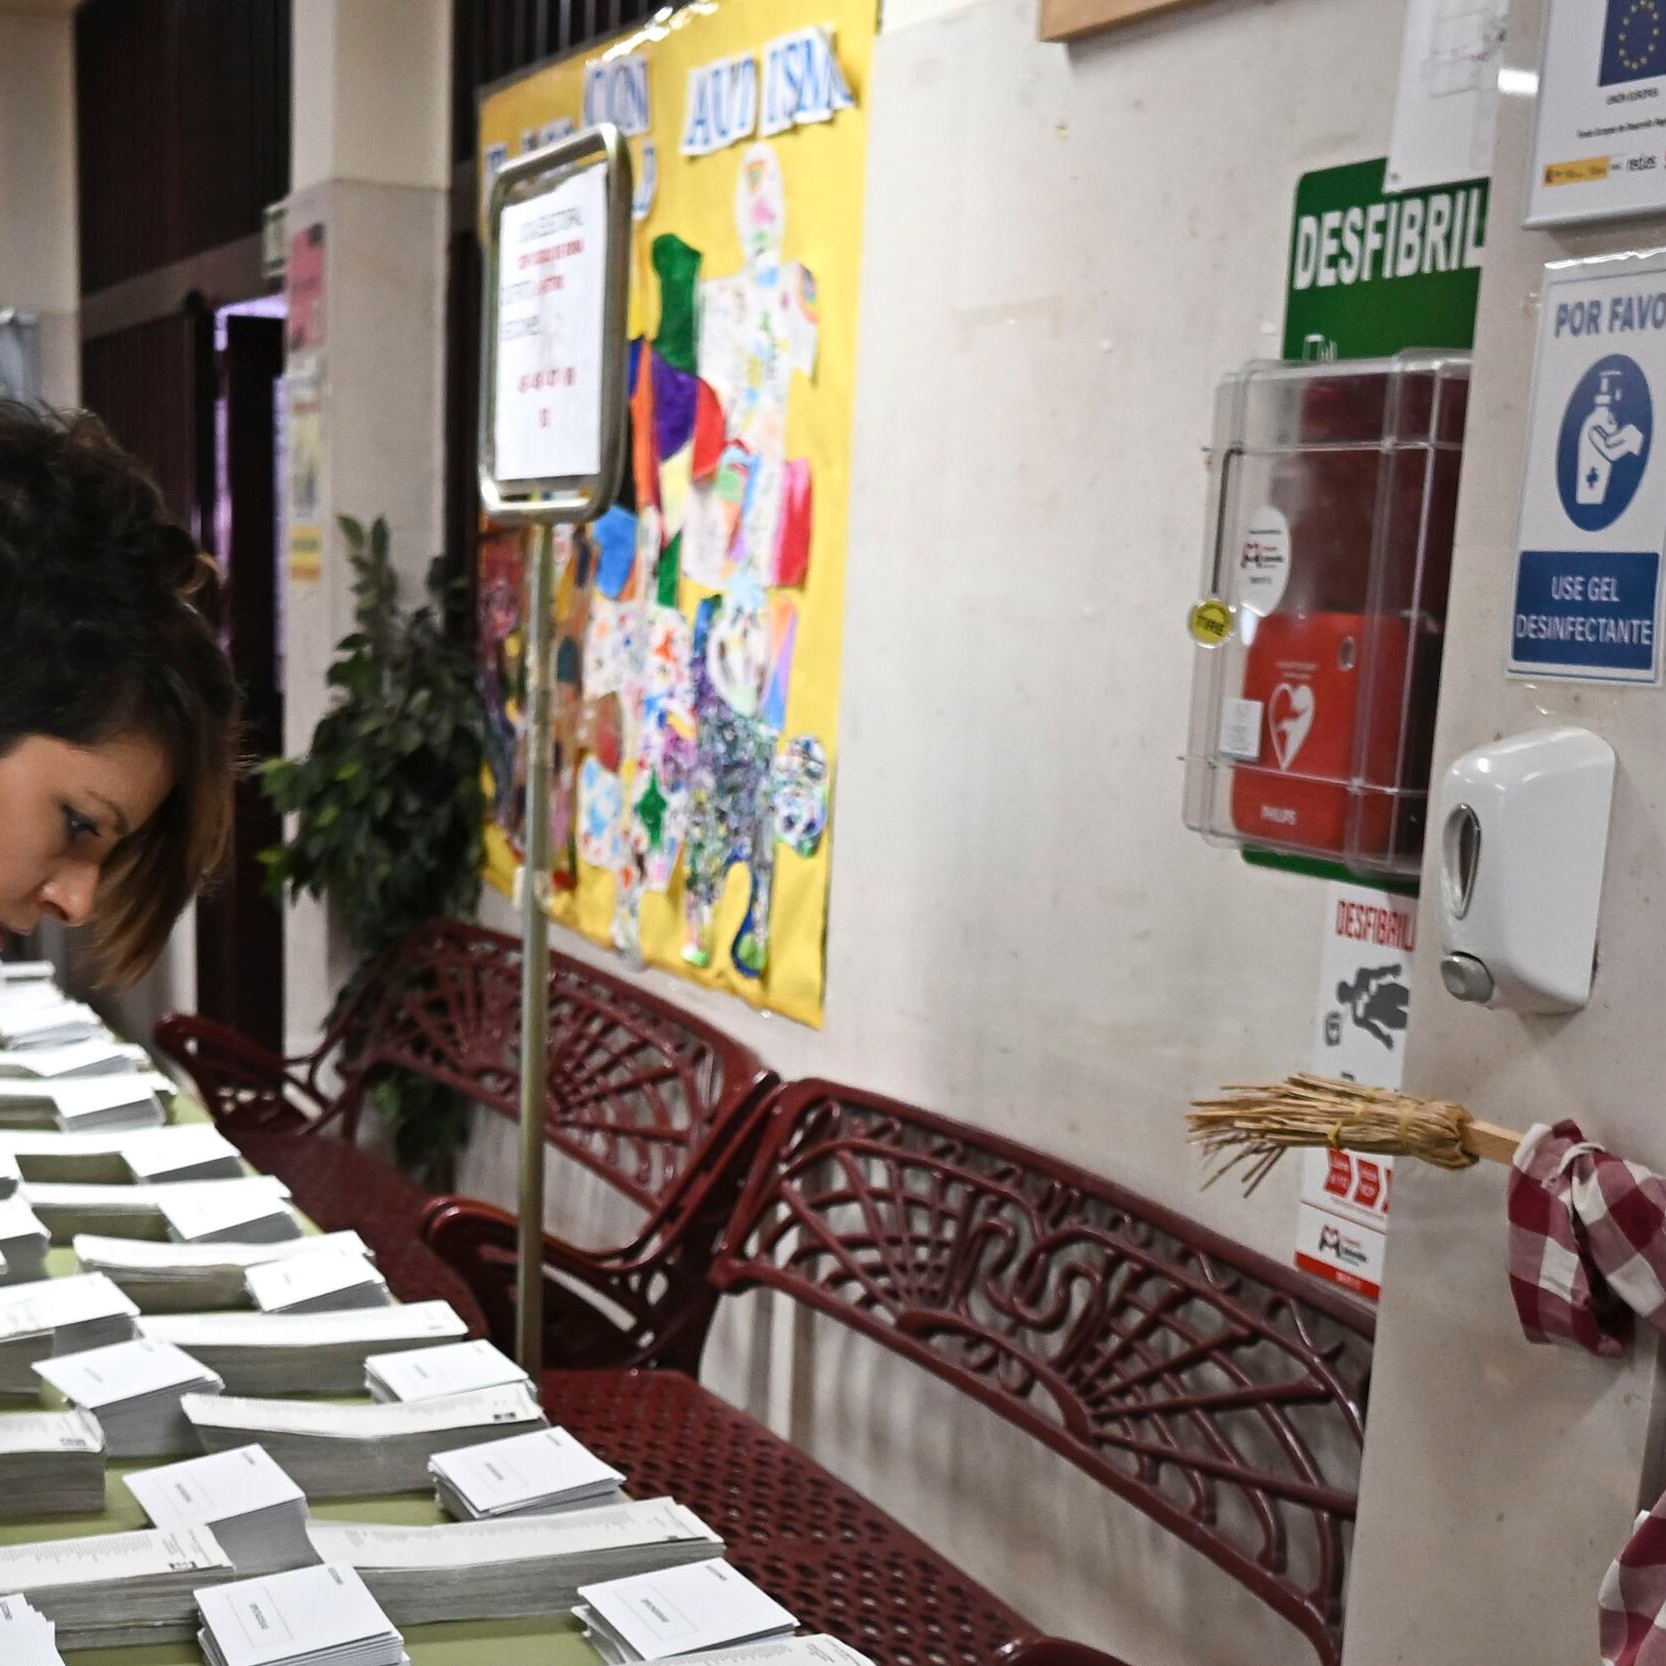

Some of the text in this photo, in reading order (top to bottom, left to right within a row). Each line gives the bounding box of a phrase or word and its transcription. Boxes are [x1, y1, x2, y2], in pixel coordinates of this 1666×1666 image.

[1293, 196, 1485, 290] DESFIBRIL
[1555, 301, 1603, 338] POR
[1551, 574, 1620, 603] USE GEL
[1515, 613, 1653, 645] DESINFECTANTE
